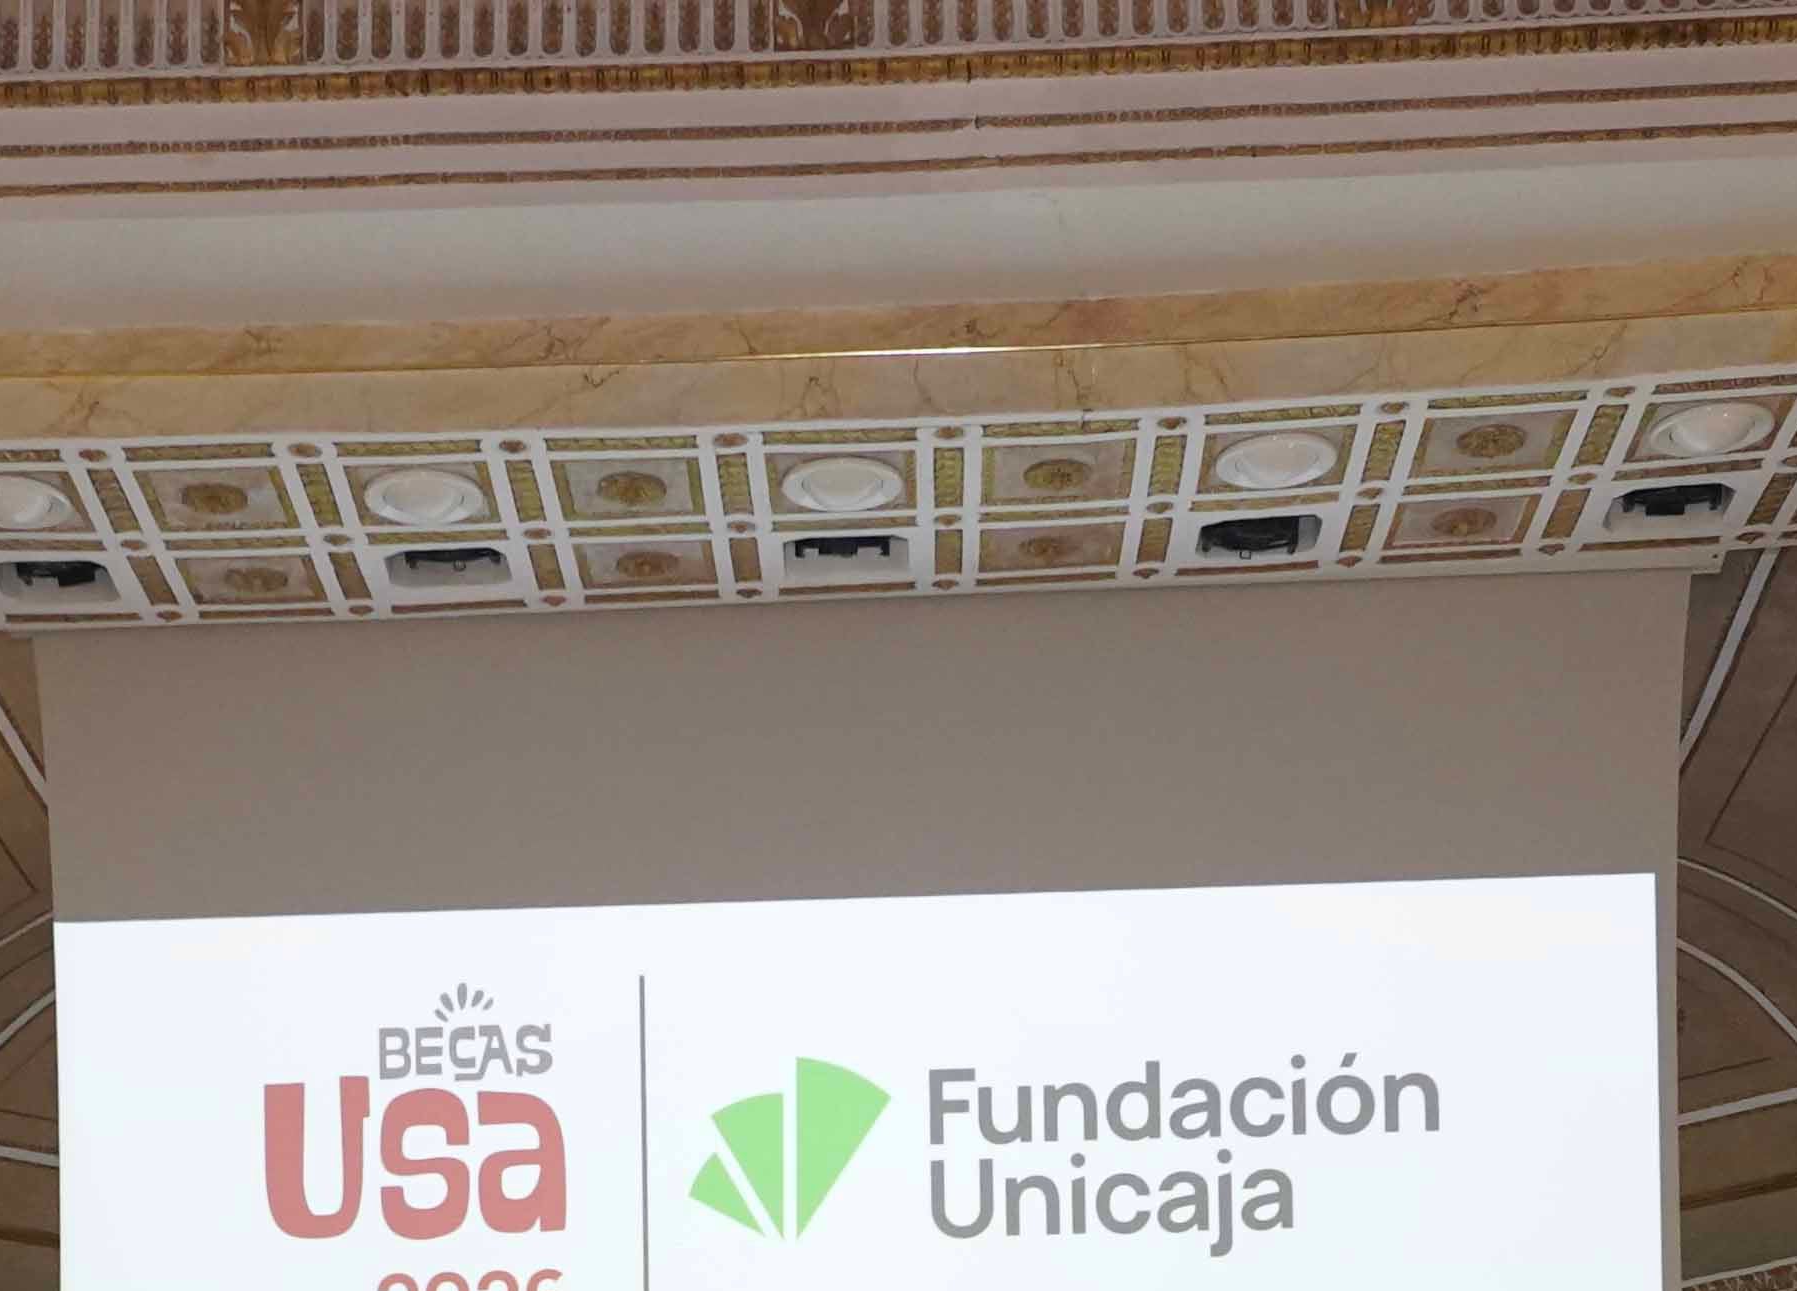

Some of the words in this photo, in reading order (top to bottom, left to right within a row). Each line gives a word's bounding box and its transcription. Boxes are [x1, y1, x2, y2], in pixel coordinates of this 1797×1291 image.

[378, 1024, 554, 1081] BECAS
[927, 1053, 1442, 1147] Fundación
[928, 1150, 1294, 1258] Unicaja
